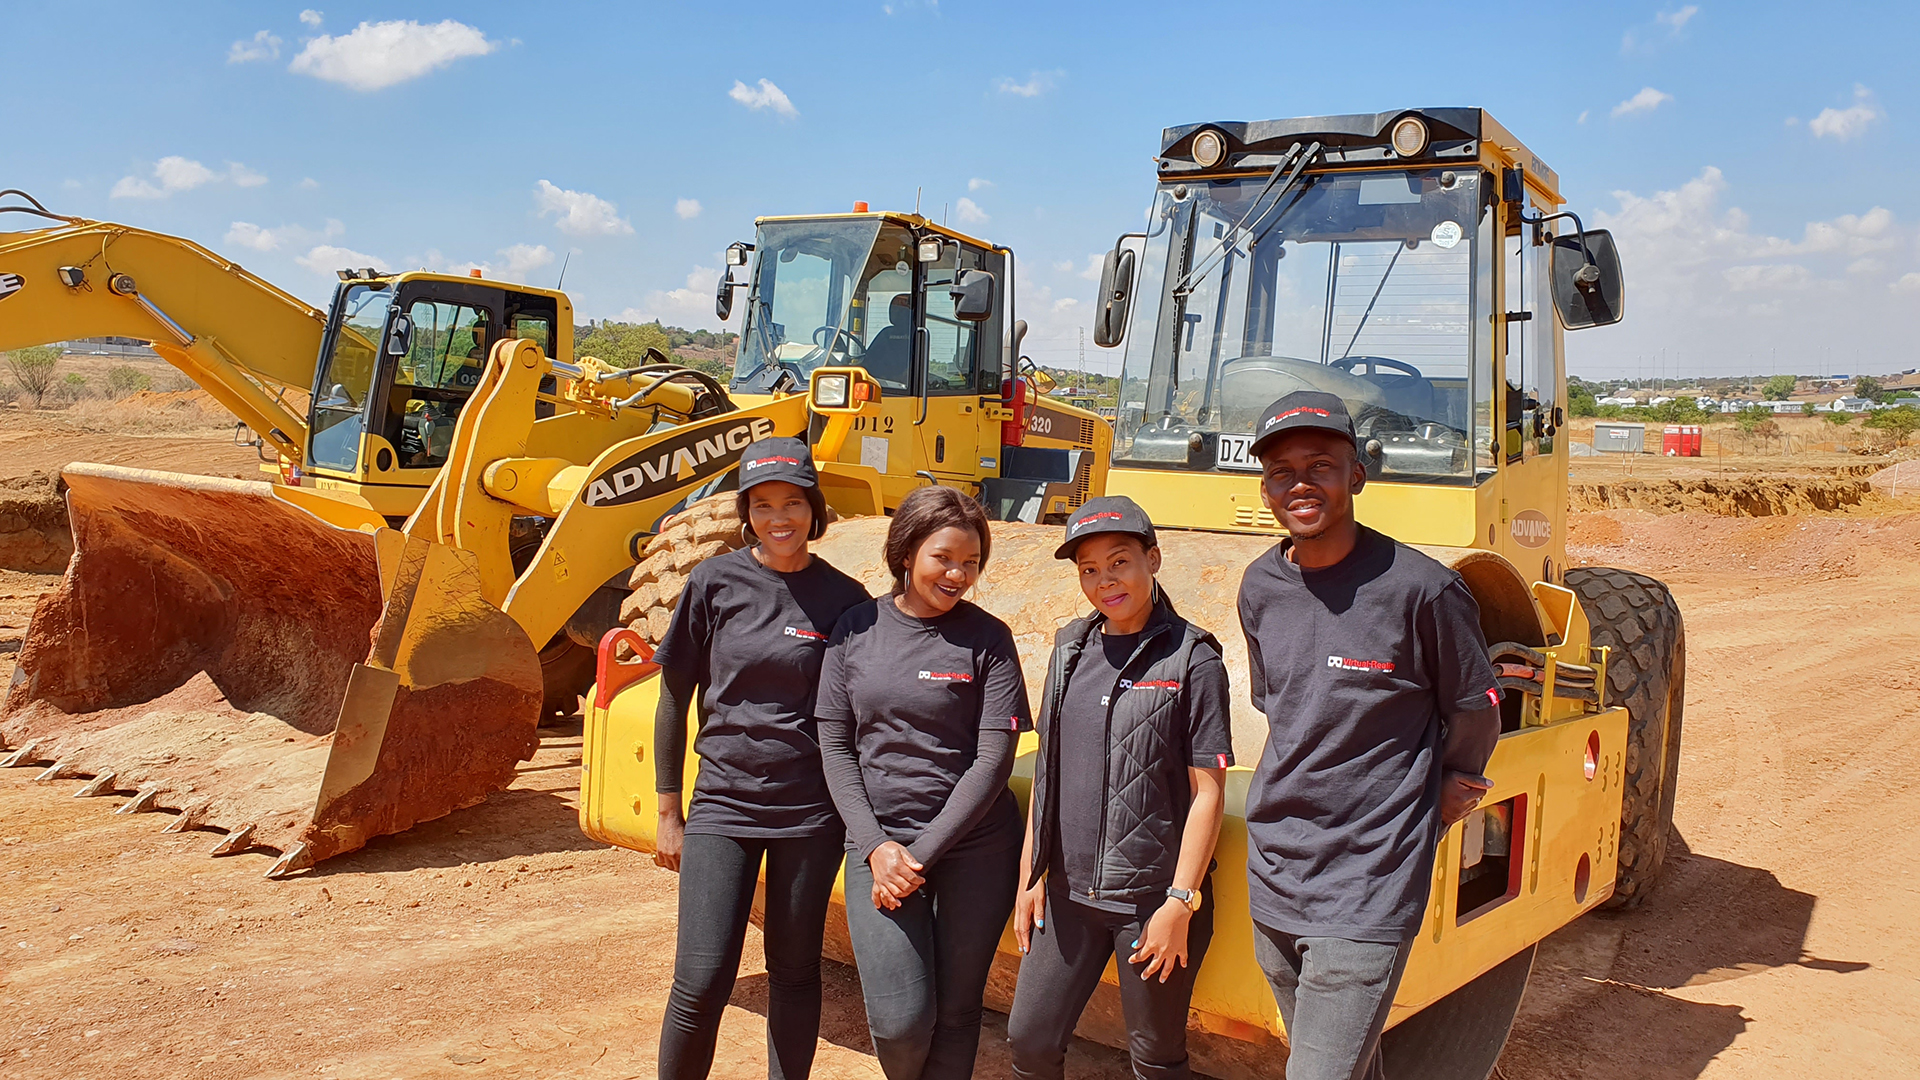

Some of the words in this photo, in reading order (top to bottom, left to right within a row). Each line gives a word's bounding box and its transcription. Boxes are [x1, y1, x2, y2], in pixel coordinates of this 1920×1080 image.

[849, 415, 894, 434] D12
[586, 417, 773, 507] ADVANCE
[1511, 519, 1551, 543] ADVANCE
[1342, 657, 1395, 671] Virtual-Reality
